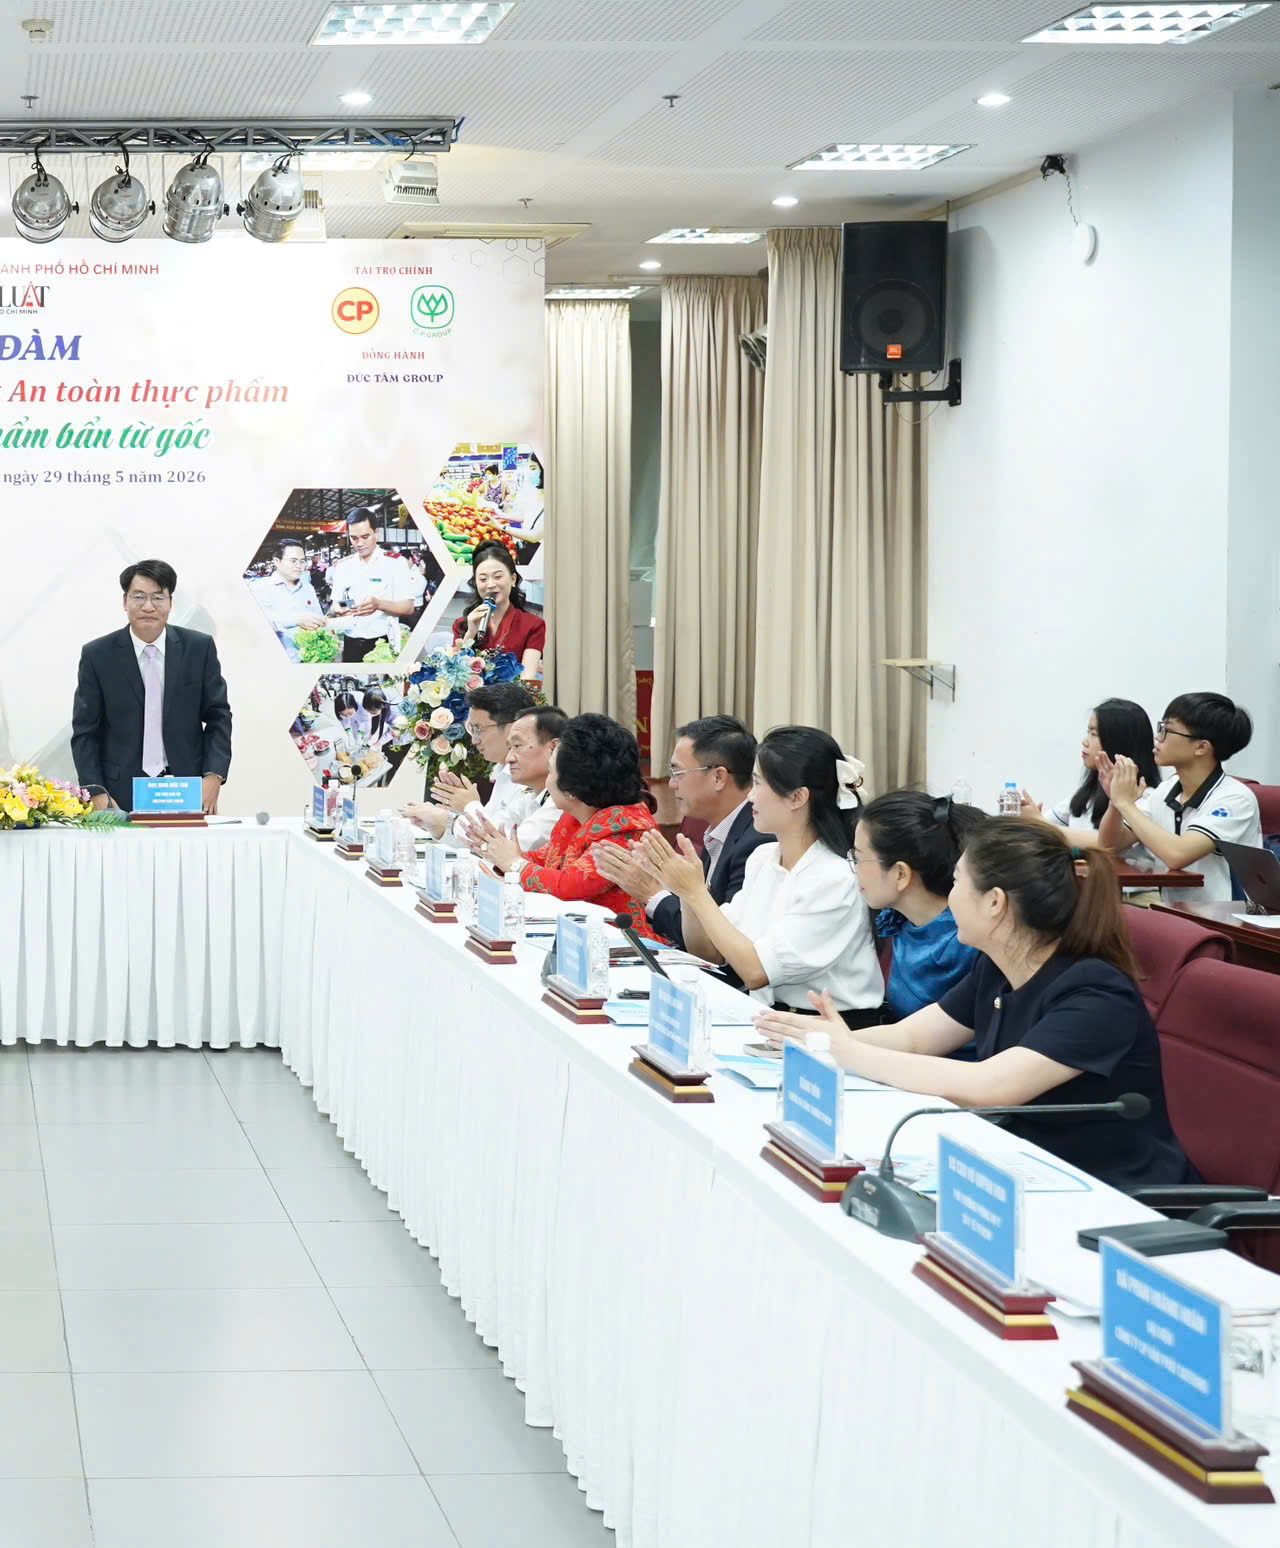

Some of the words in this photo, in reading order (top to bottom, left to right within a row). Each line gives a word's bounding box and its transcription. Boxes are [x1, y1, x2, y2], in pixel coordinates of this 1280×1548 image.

[35, 259, 65, 275] PHỐ
[69, 258, 89, 275] HỒ
[92, 260, 118, 275] CHÍ
[121, 263, 160, 275] MINH
[337, 300, 374, 322] CP
[403, 373, 443, 384] GROUP
[6, 379, 47, 402] An
[56, 378, 120, 402] toàn
[130, 378, 198, 409] thực
[205, 376, 288, 409] phẩm
[55, 416, 114, 449] bẩn
[118, 421, 154, 449] từ
[153, 418, 210, 458] gốc
[4, 469, 39, 487] ngày
[44, 470, 63, 483] 29
[68, 469, 111, 487] tháng
[116, 470, 124, 484] 5
[129, 469, 162, 483] năm
[167, 470, 206, 483] 2026
